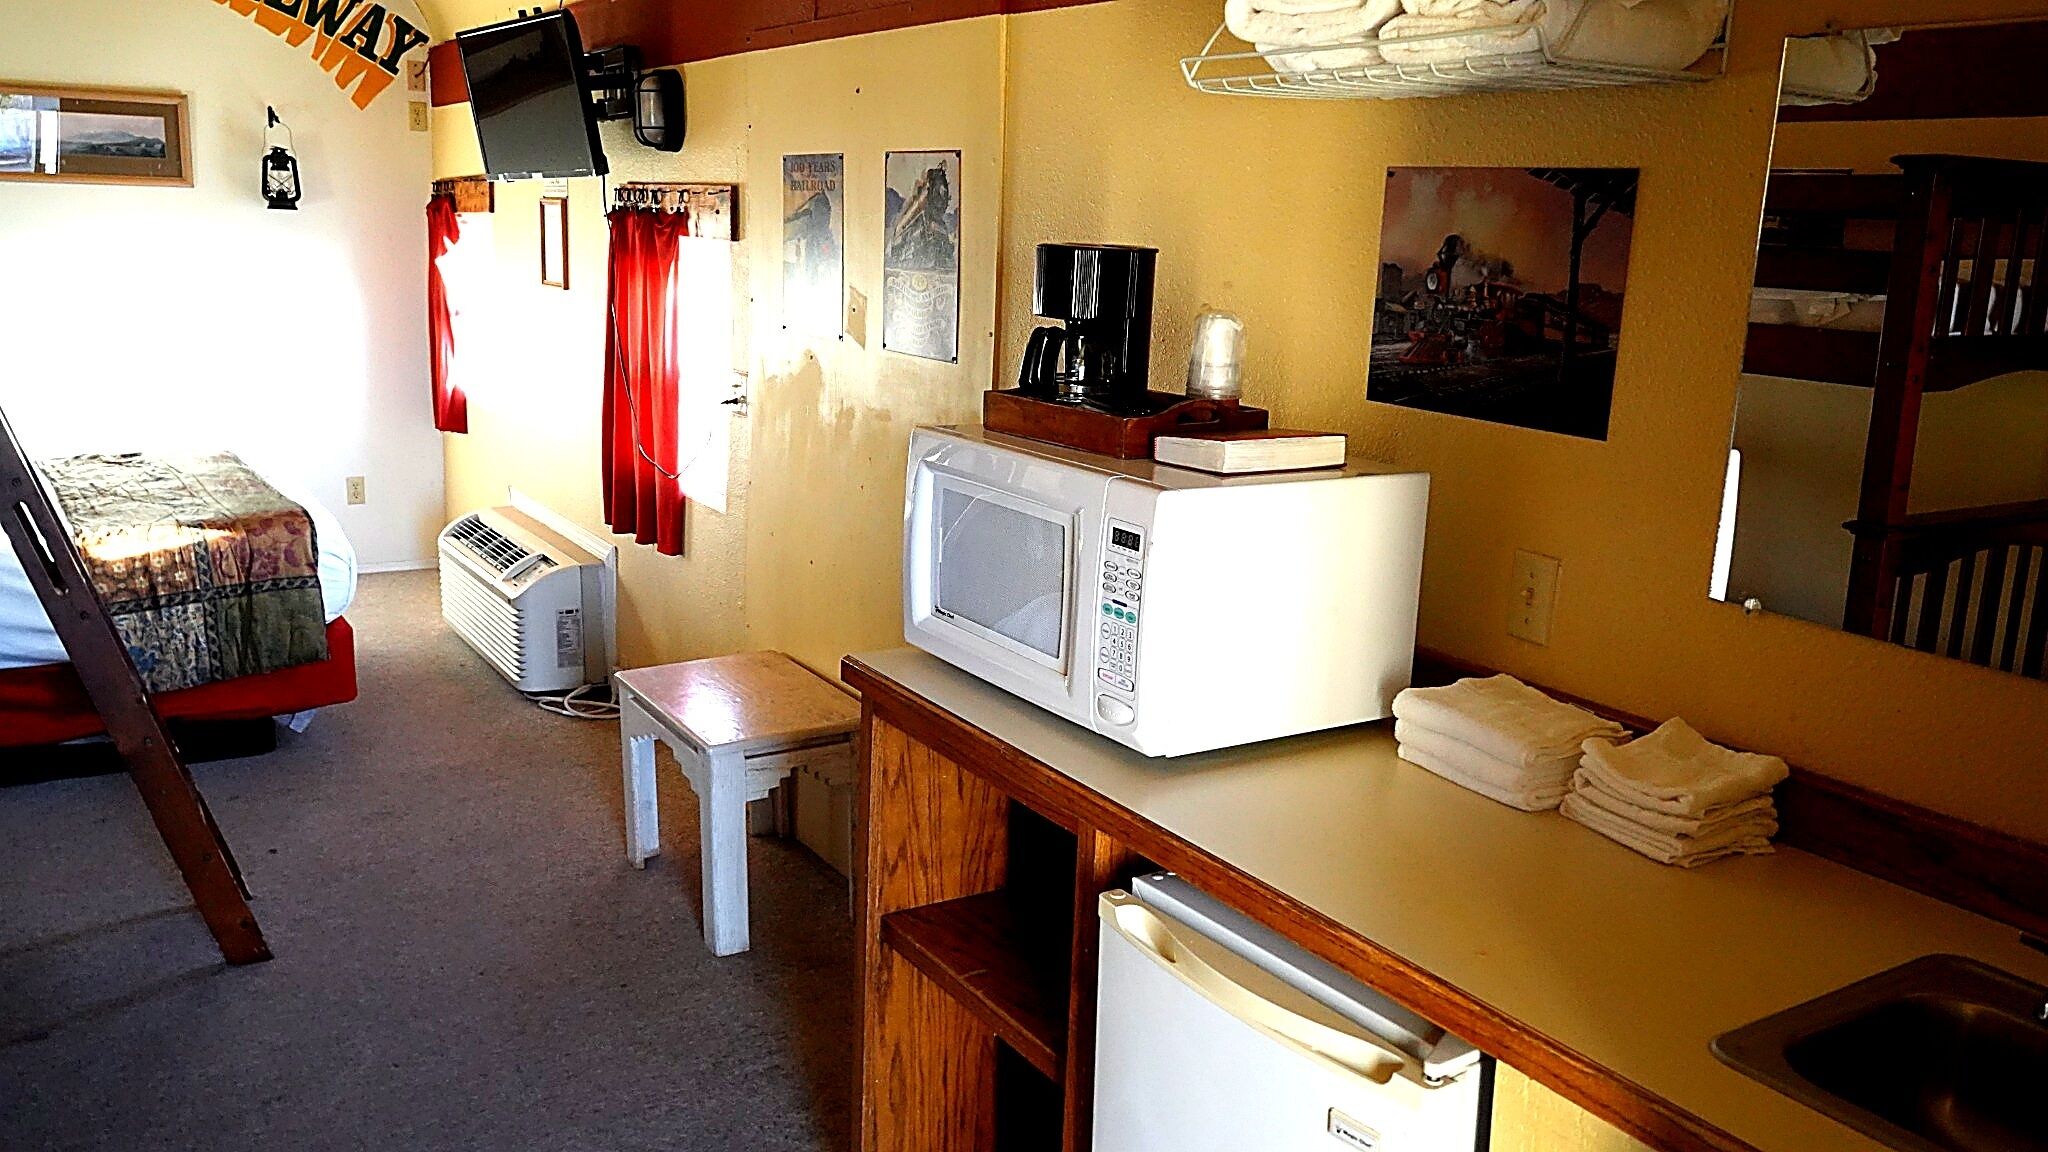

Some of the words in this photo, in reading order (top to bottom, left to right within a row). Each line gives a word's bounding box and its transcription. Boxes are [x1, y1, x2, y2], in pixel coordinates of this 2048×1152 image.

[790, 161, 805, 173] 100
[807, 160, 836, 173] YEARS
[790, 179, 836, 191] RAILROAD
